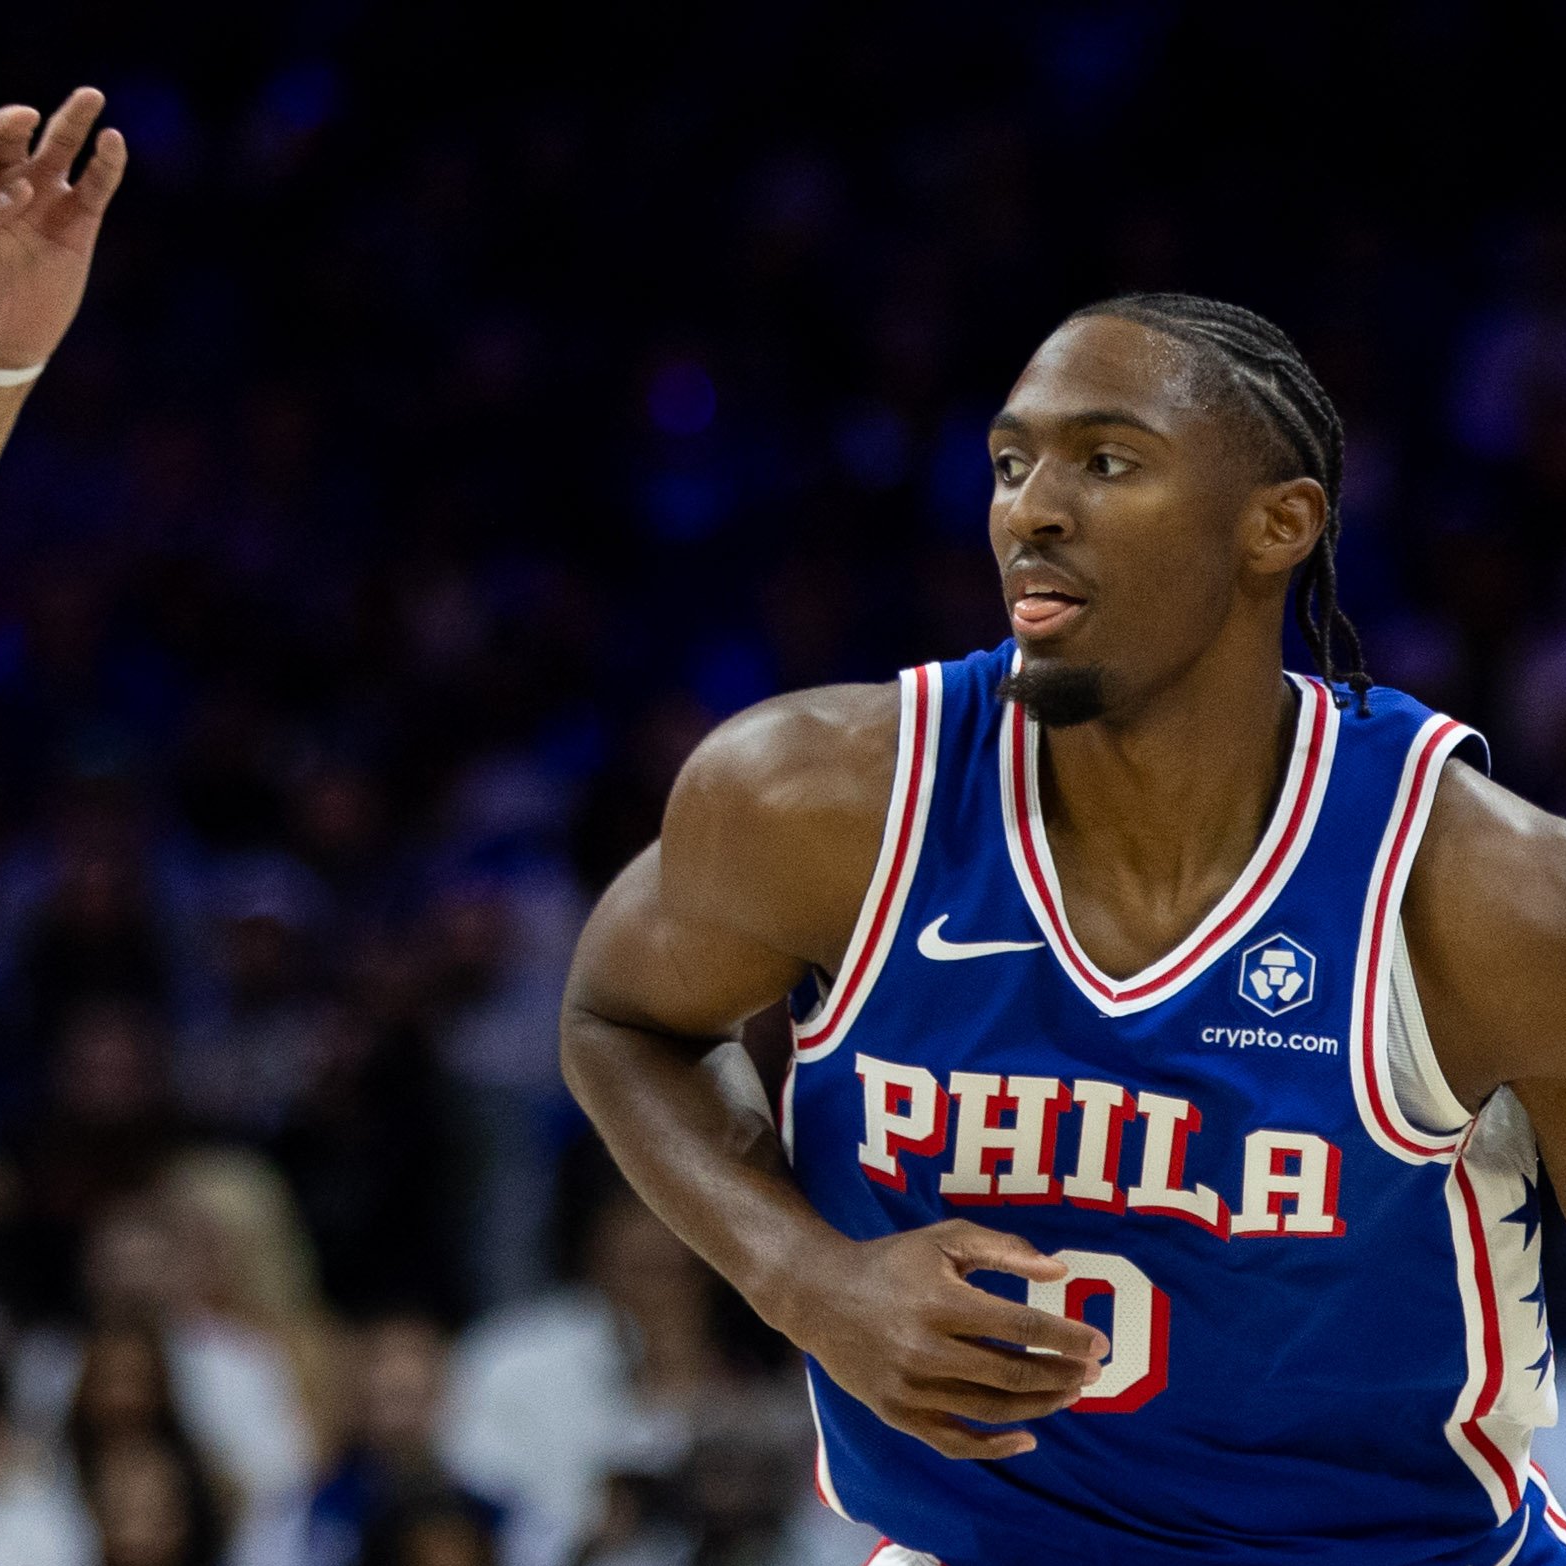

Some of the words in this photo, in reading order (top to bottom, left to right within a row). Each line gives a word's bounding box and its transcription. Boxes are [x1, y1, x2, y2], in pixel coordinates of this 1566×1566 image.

[1201, 1027, 1339, 1055] crypto.com
[855, 1053, 1346, 1242] PHILA
[1026, 1249, 1170, 1413] 0
